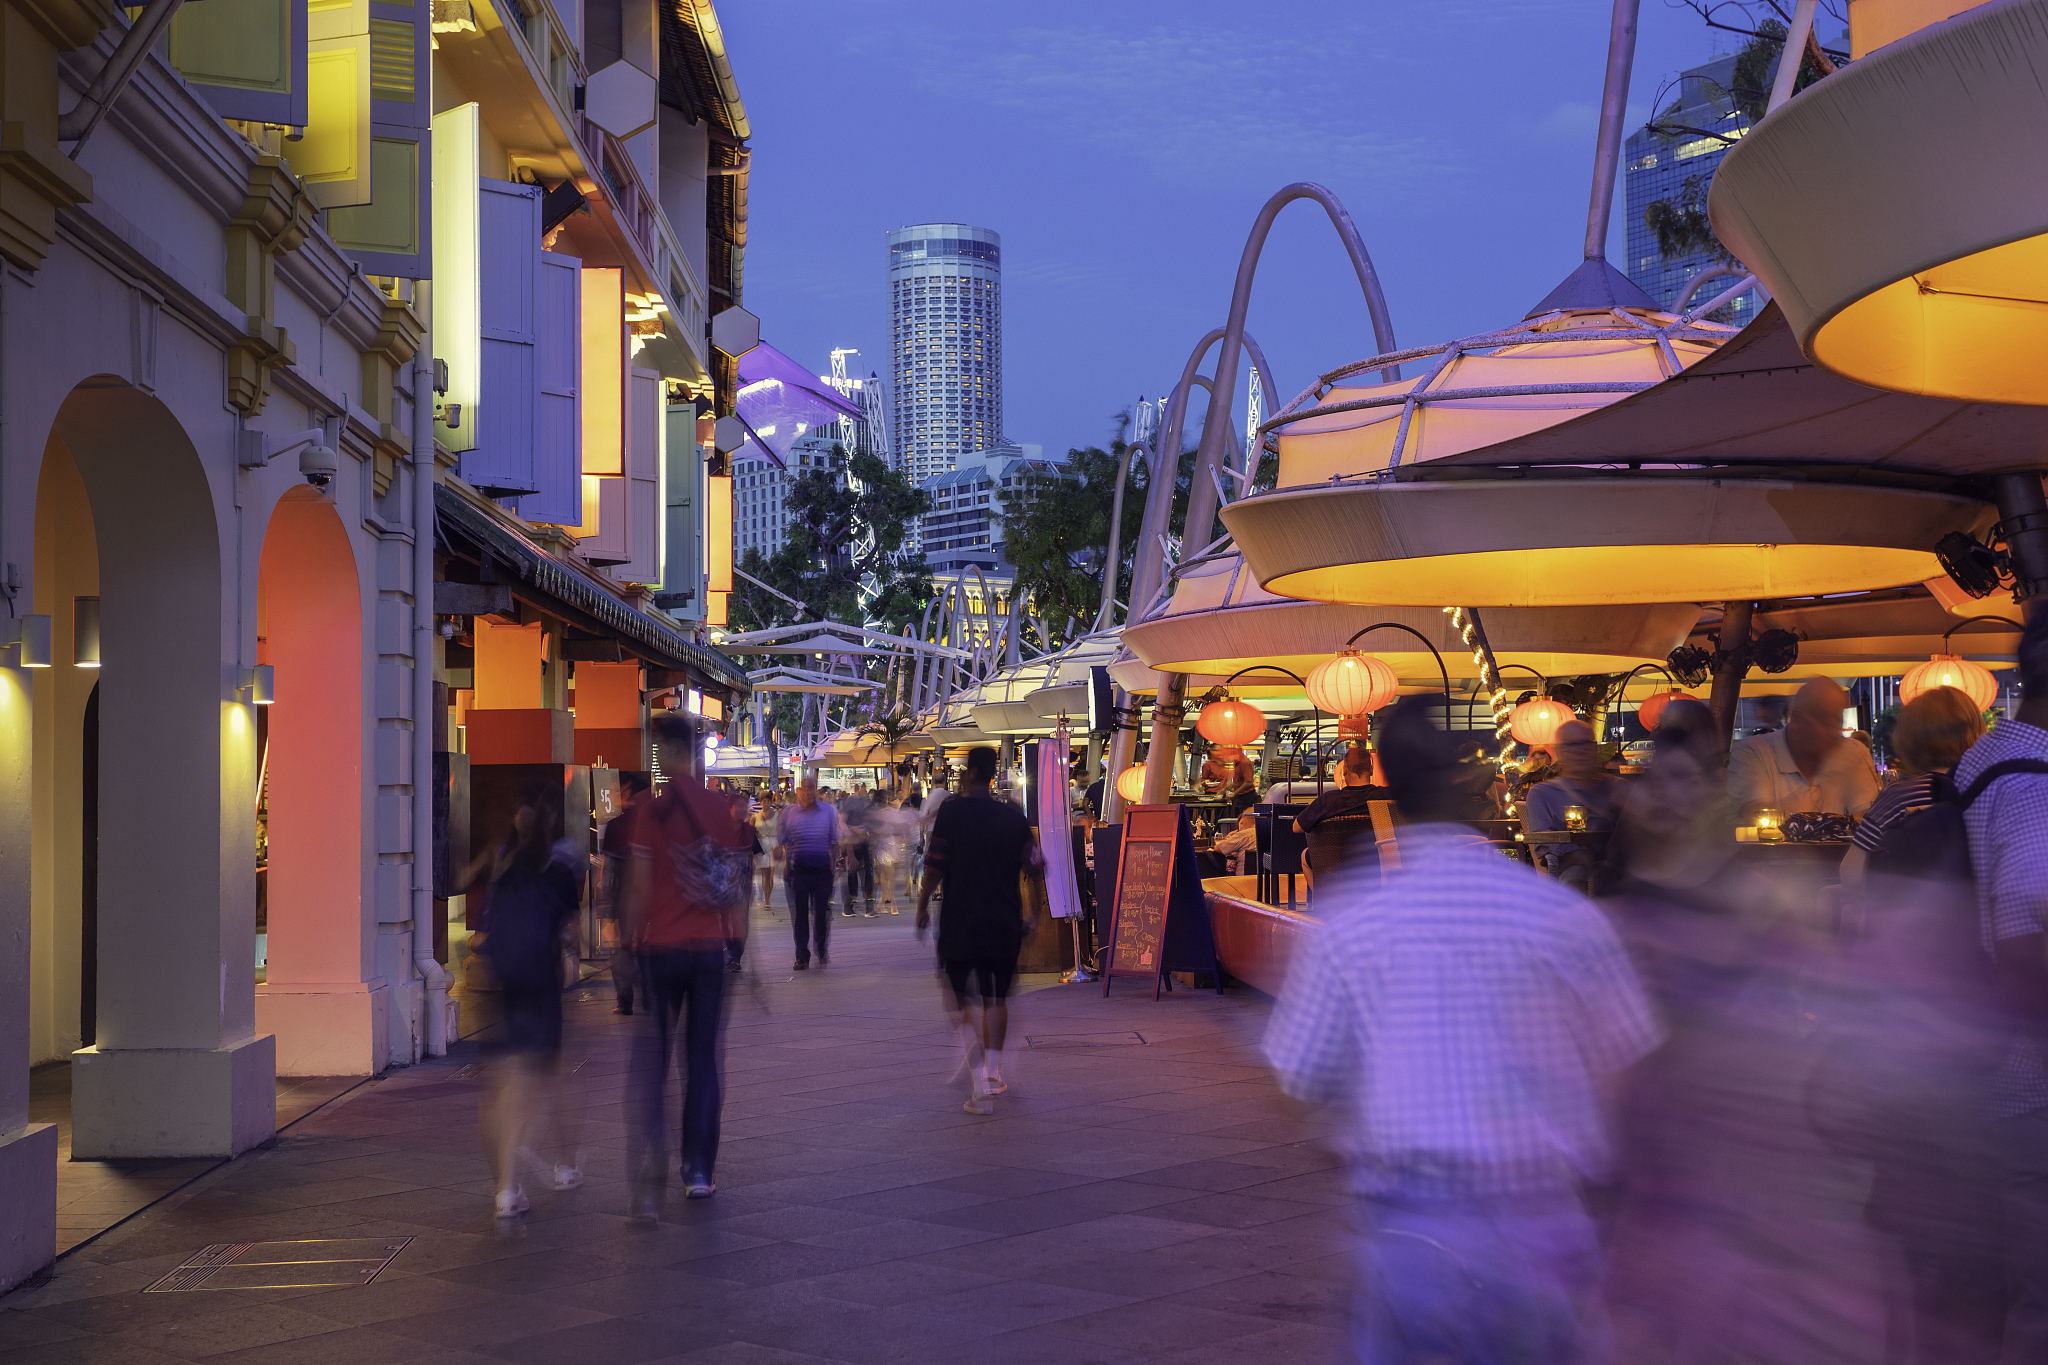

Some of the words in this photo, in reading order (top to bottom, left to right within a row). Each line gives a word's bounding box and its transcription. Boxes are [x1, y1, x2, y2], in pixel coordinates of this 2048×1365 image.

[600, 788, 612, 814] $5
[1129, 844, 1149, 862] Happy
[1149, 845, 1163, 858] Hour
[1131, 862, 1137, 876] 1
[1145, 861, 1150, 876] 1
